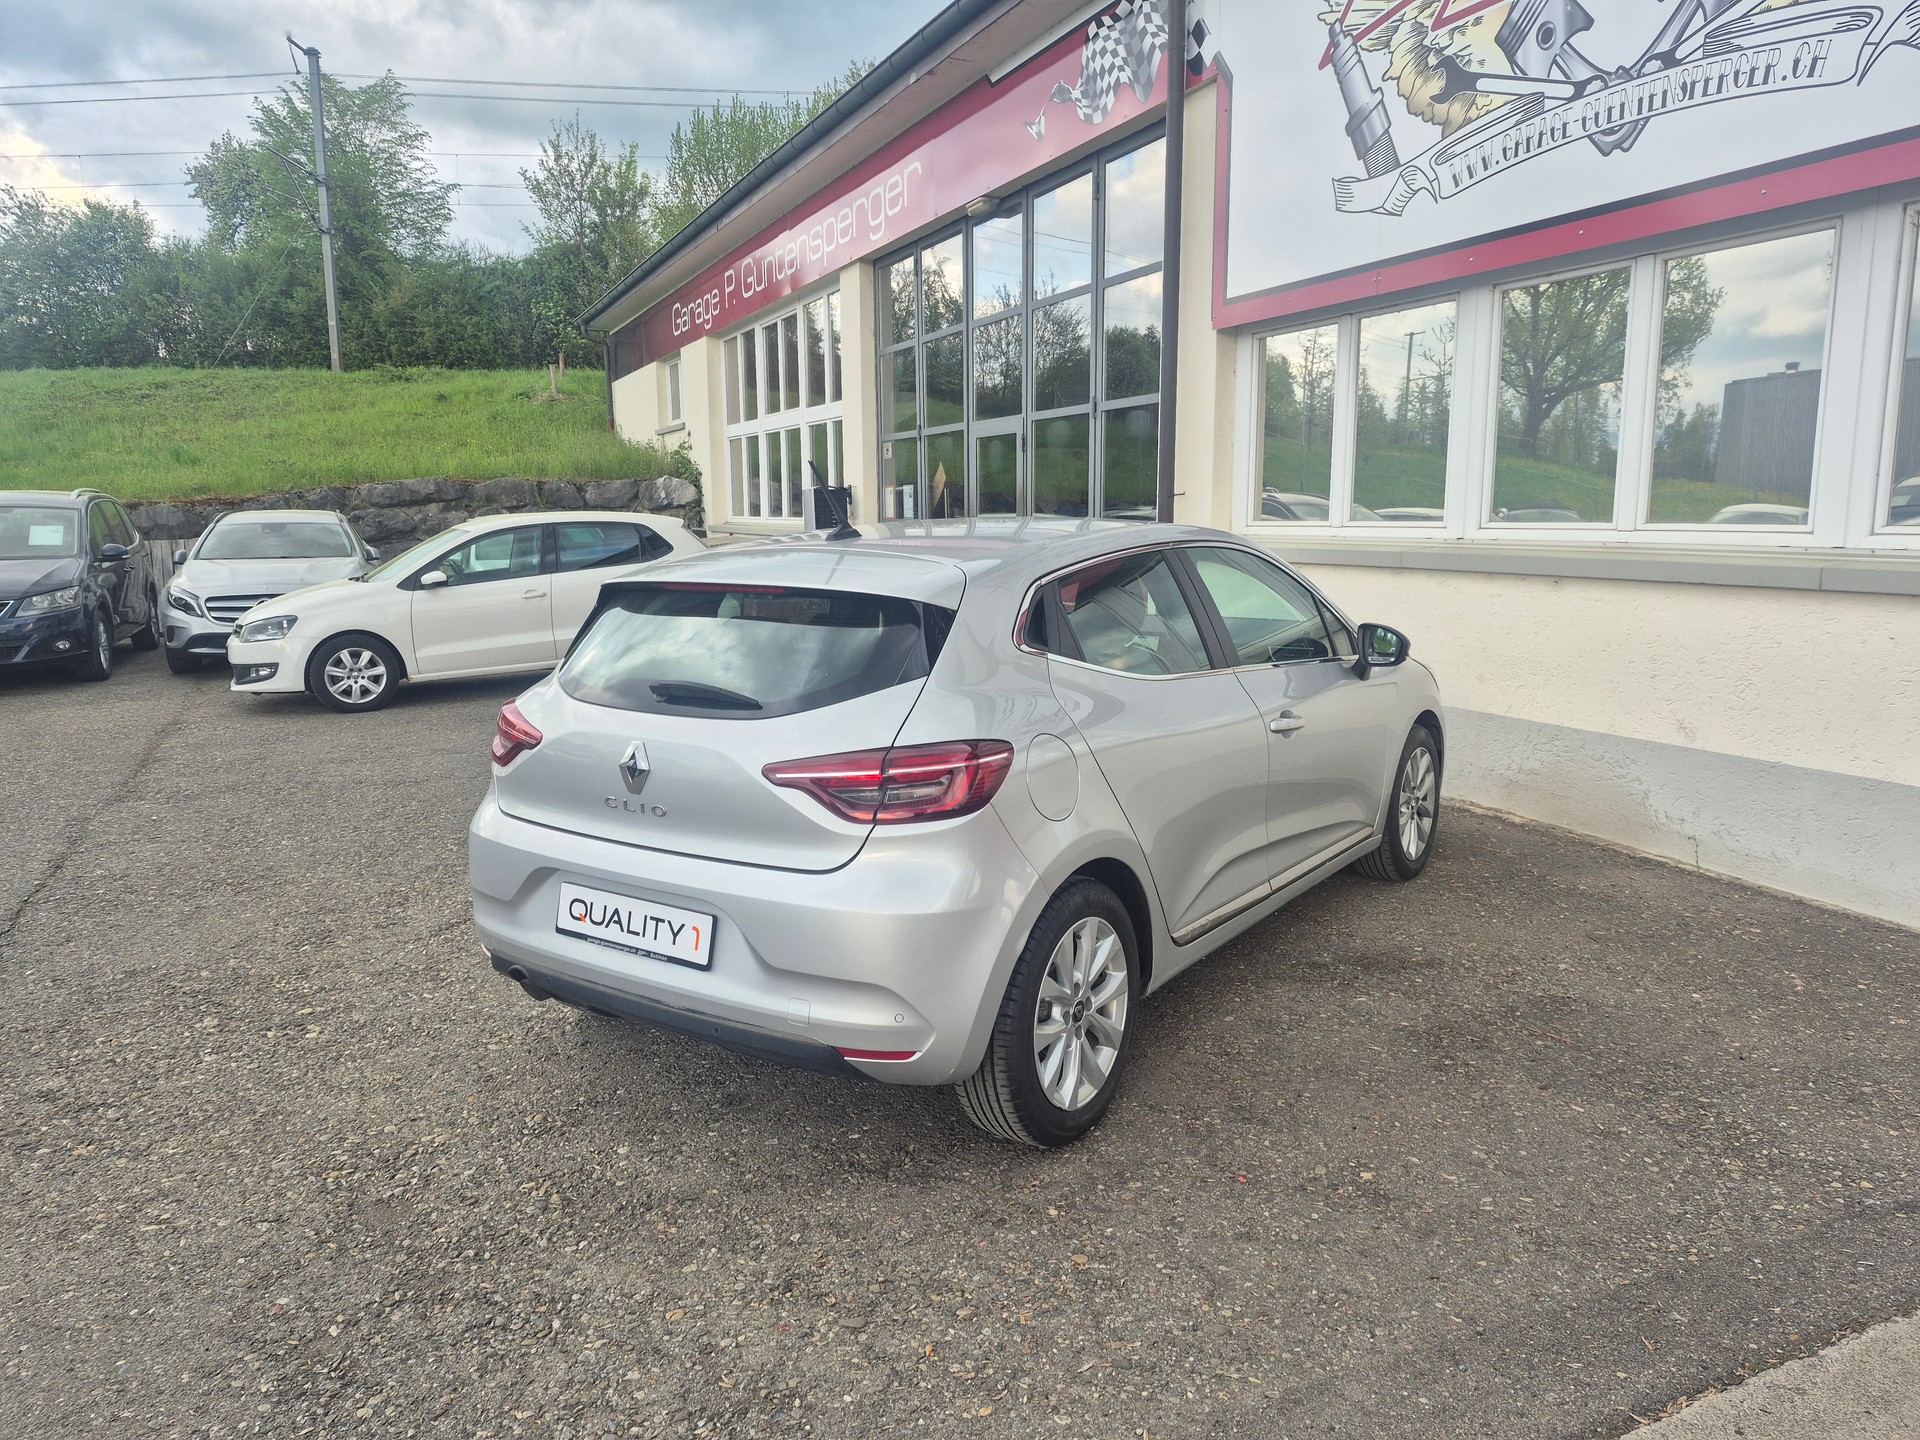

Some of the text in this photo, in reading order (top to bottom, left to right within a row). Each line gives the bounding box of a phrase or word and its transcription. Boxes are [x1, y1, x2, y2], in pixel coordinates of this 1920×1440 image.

[671, 160, 922, 338] Garage P. Güntensperger
[604, 795, 668, 818] CLIO
[568, 897, 701, 951] QUALITY 1
